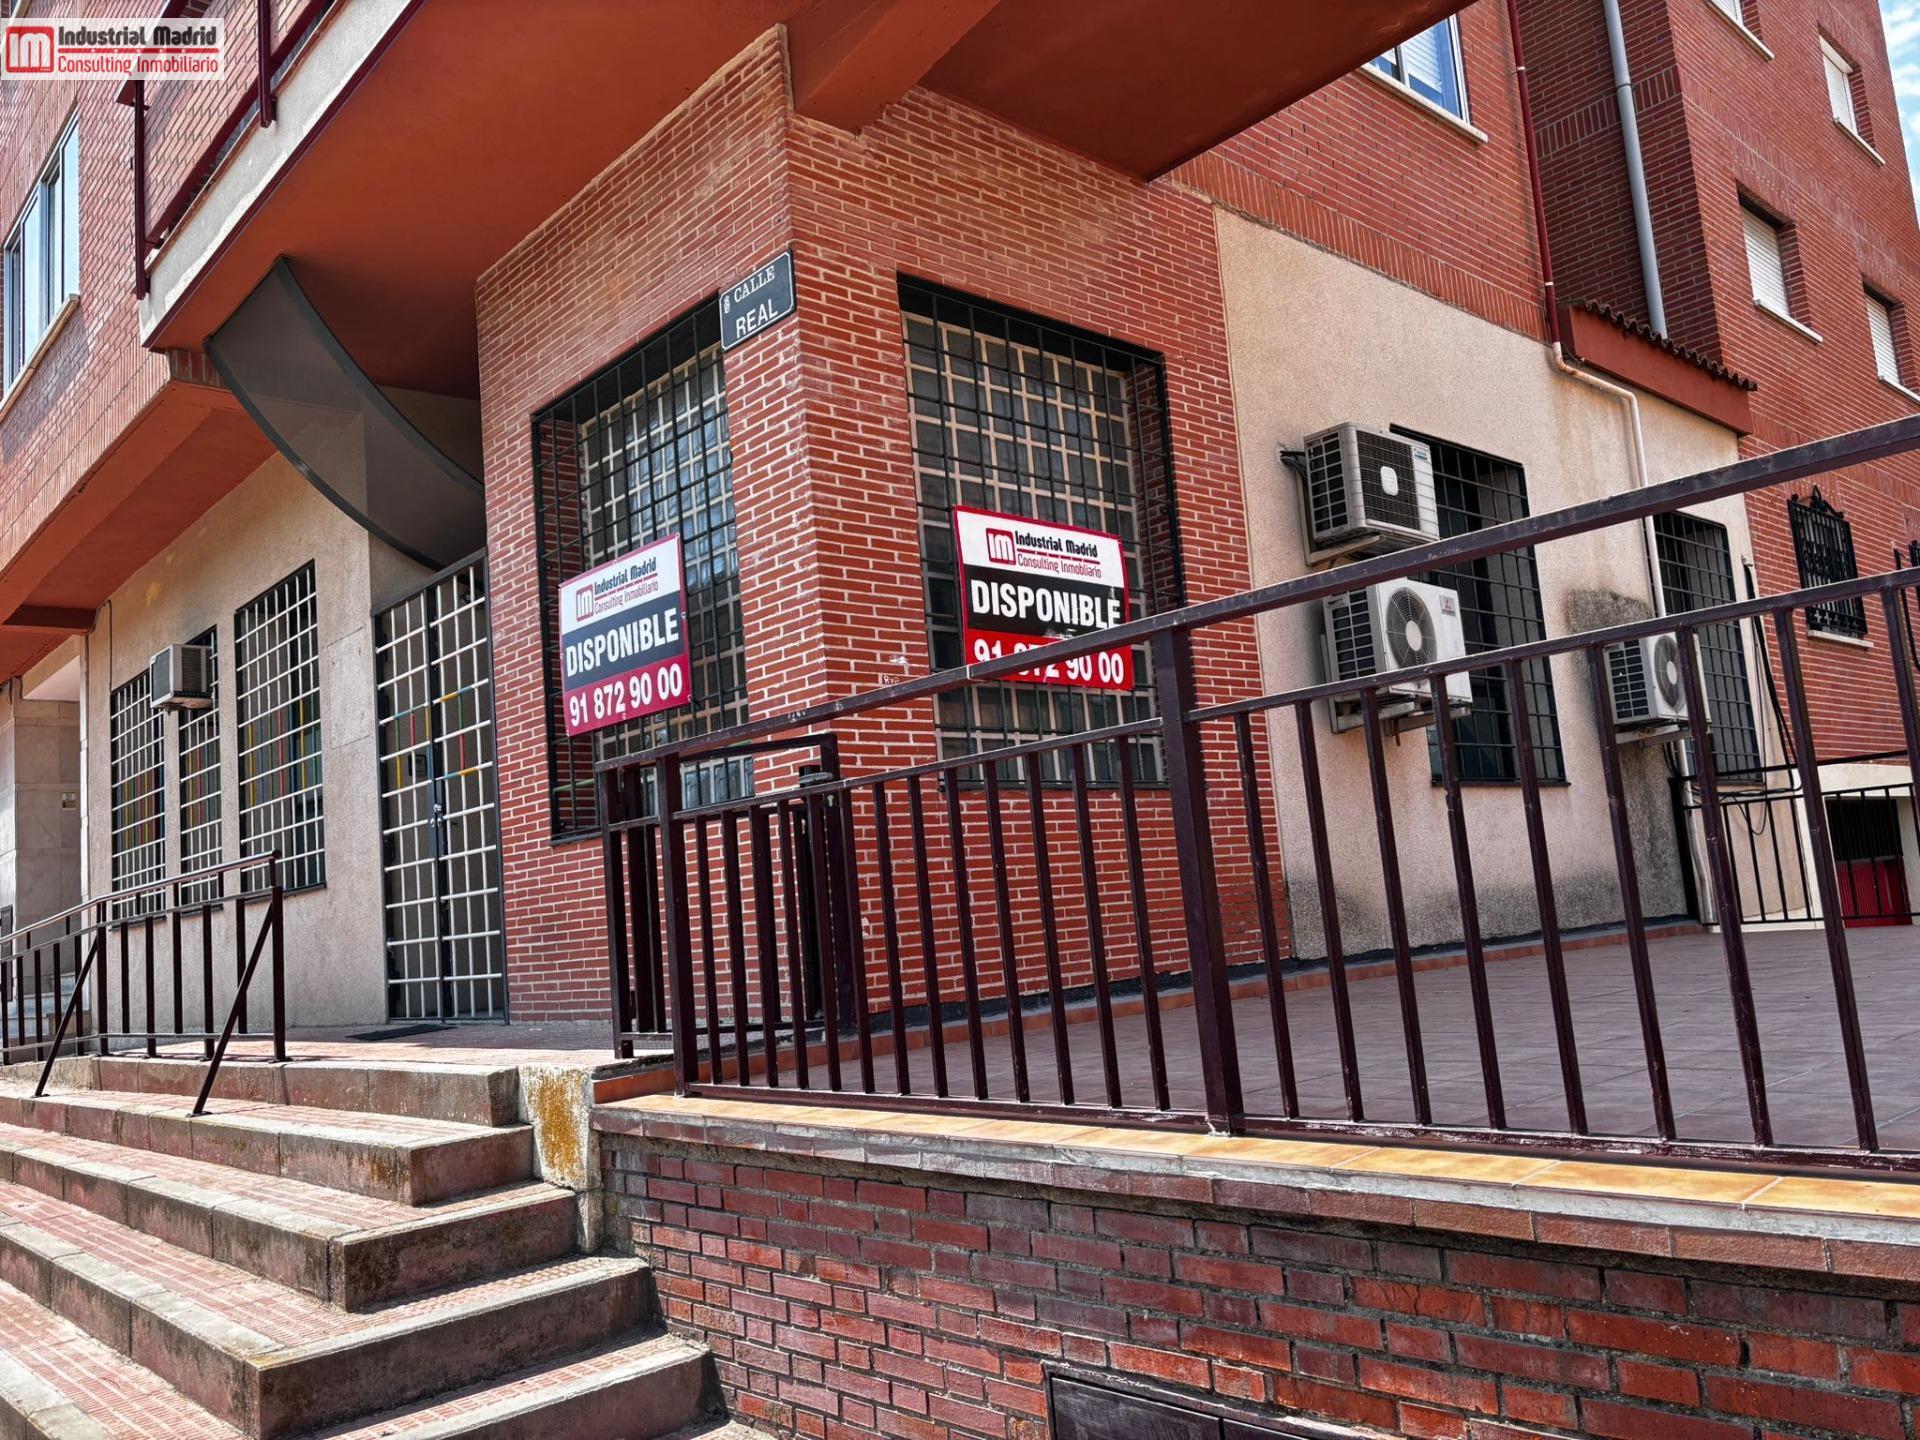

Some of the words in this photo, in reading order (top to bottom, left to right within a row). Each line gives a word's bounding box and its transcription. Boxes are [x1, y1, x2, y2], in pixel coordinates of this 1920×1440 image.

[733, 265, 776, 303] CALLE
[735, 298, 778, 339] REAL
[1015, 530, 1063, 552] Industrial
[1066, 539, 1098, 558] Madrid
[594, 568, 628, 596] Industrial
[630, 556, 657, 581] Madrid
[1017, 553, 1060, 574] Consulting
[1061, 560, 1102, 579] Inmobiliario
[594, 594, 624, 615] Consulting
[970, 579, 1121, 629] DISPONIBLE
[566, 607, 679, 677] DISPONIBLE
[1065, 653, 1093, 681] 90
[1098, 651, 1124, 684] 00
[569, 692, 589, 727] 91
[593, 680, 626, 719] 872
[629, 671, 652, 709] 90
[657, 663, 683, 701] 00
